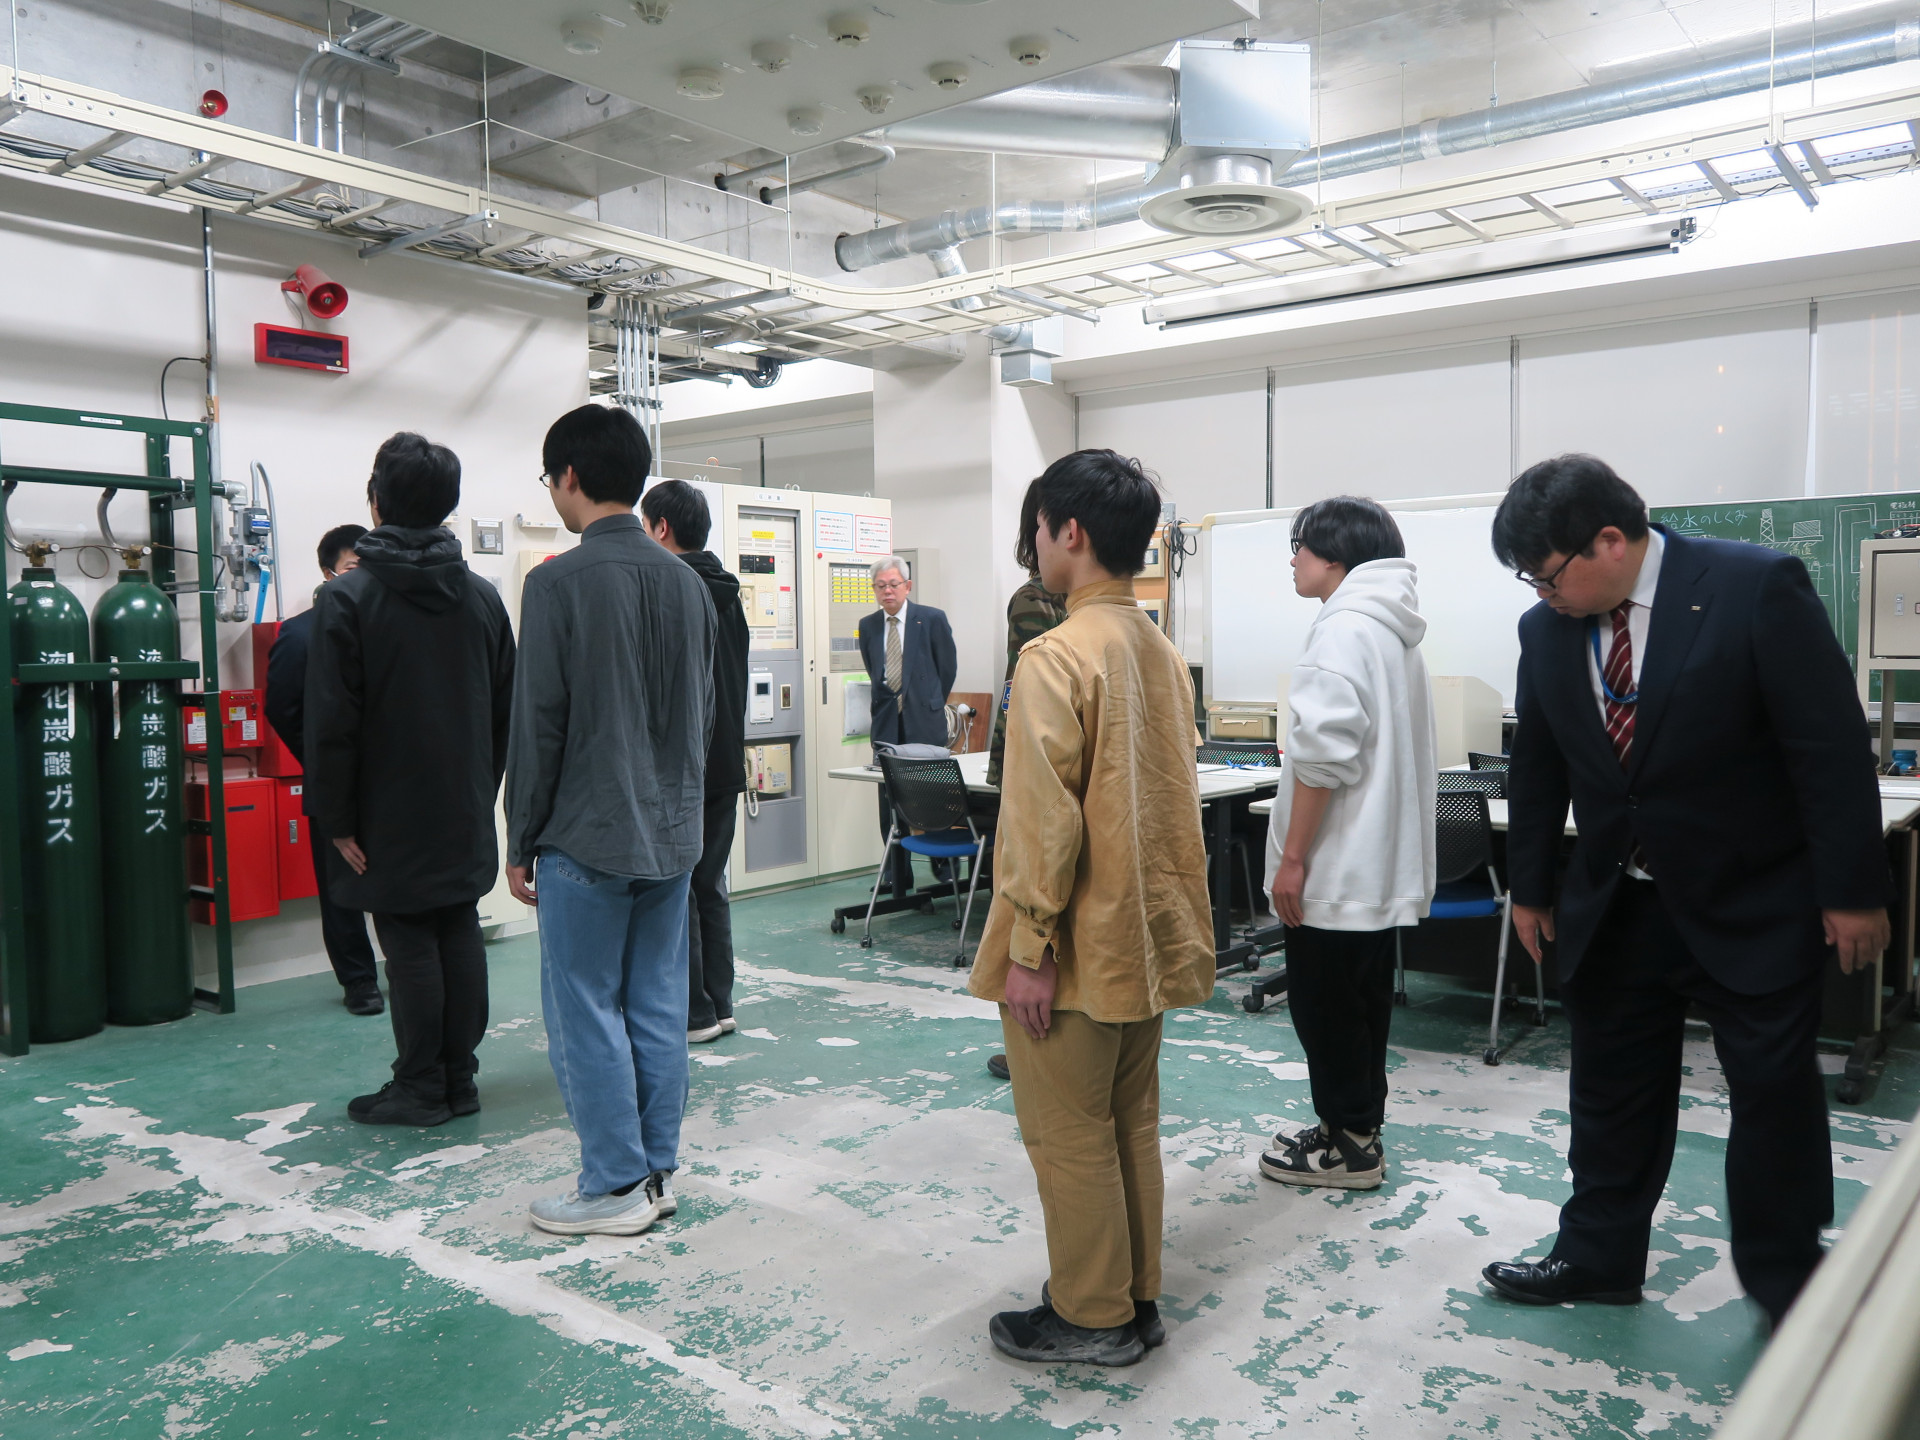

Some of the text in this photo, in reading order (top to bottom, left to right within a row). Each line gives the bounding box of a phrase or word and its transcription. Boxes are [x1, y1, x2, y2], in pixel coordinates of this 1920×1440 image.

[1660, 509, 1748, 530] 給水のしくみ
